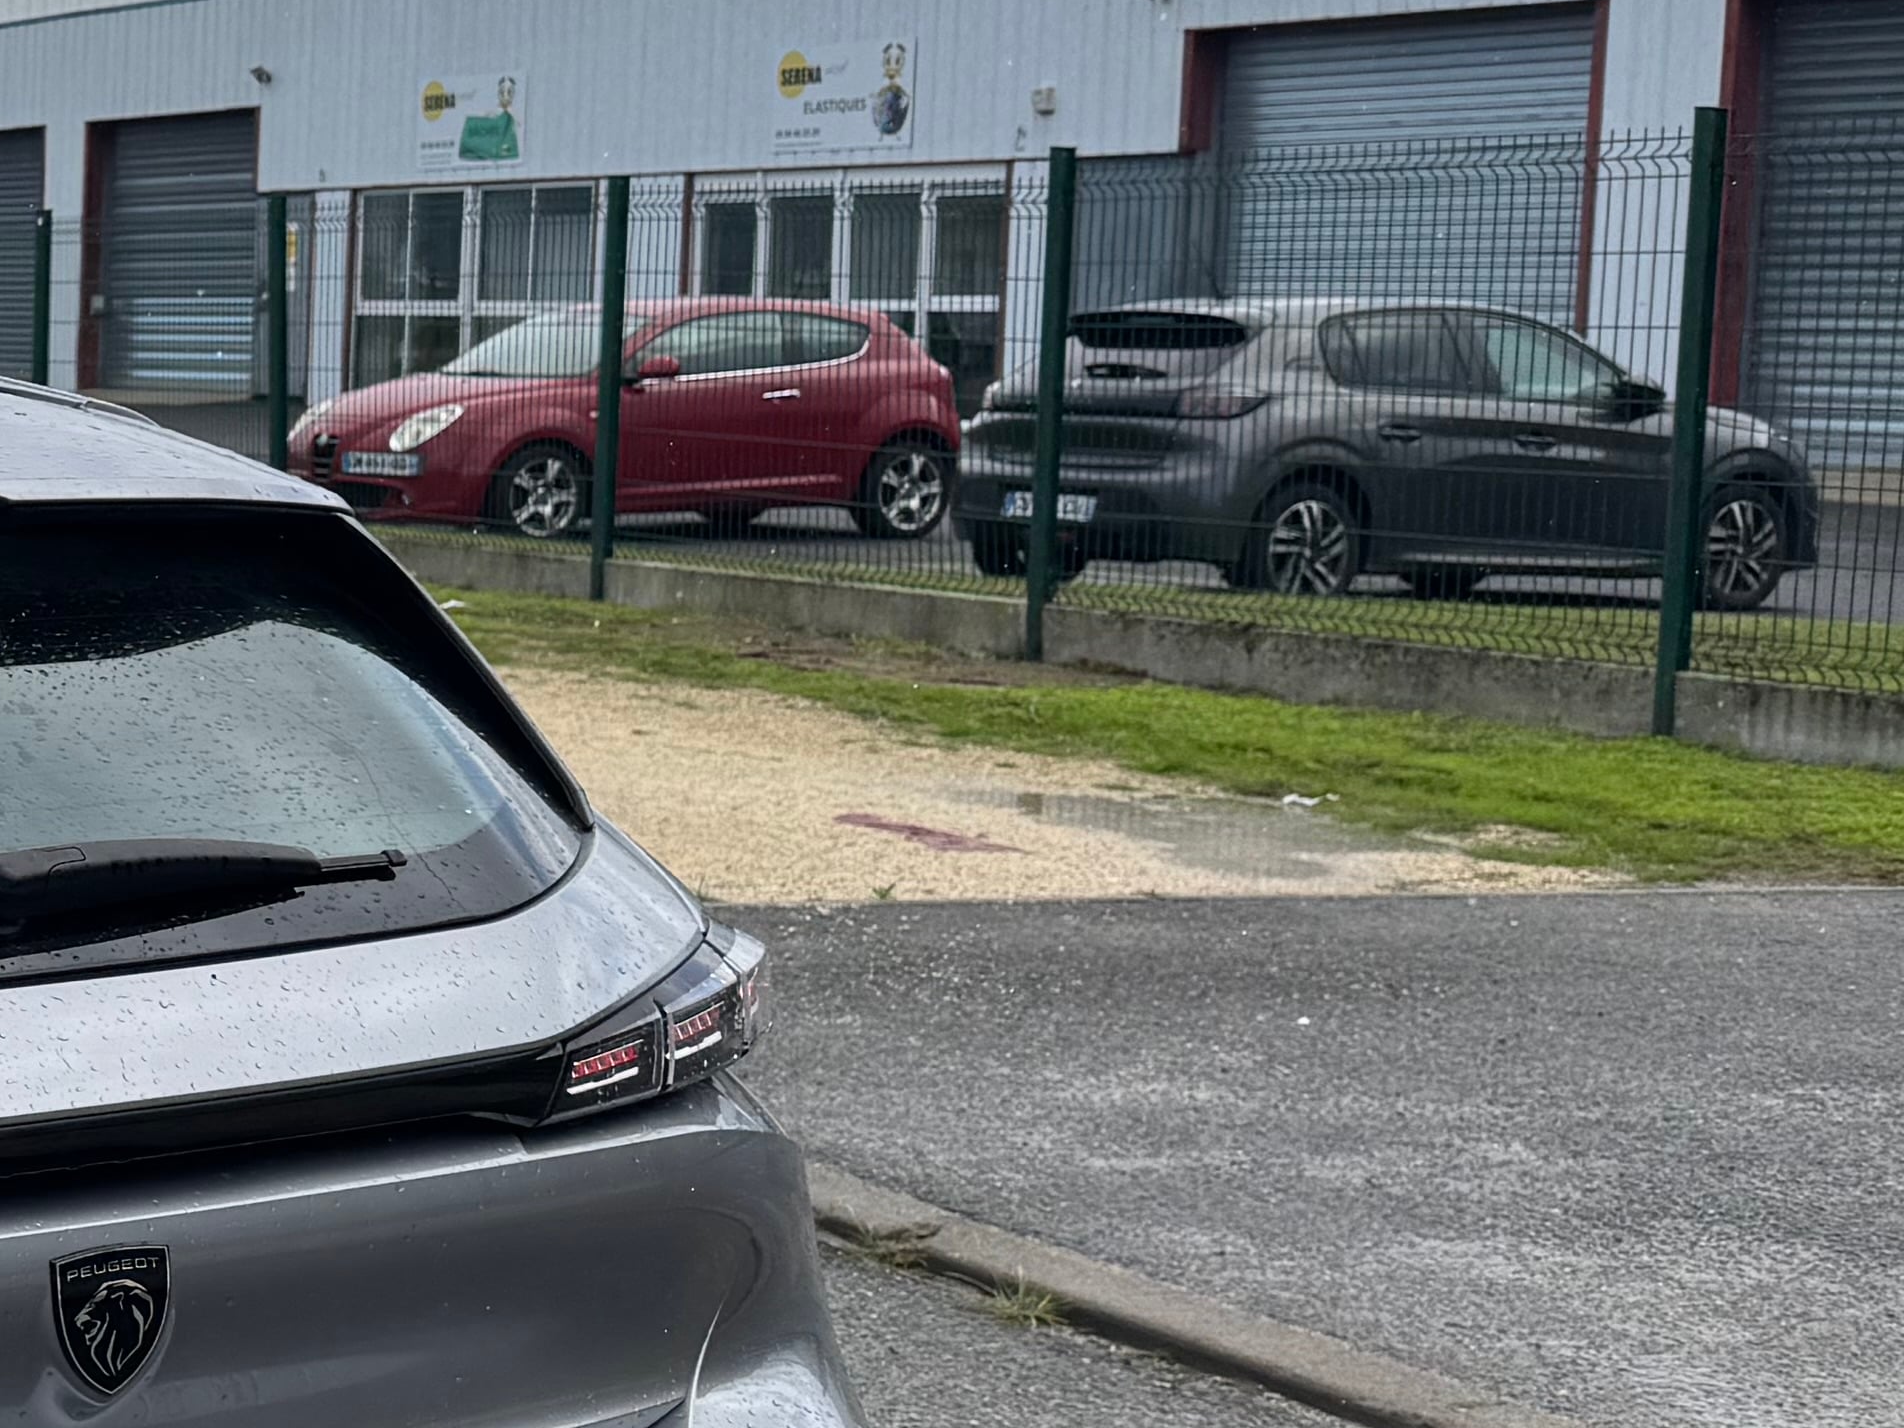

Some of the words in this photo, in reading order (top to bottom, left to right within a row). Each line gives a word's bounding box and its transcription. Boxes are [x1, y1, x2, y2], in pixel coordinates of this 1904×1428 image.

[781, 65, 822, 86] SERENA
[424, 93, 456, 112] SERENA
[66, 1256, 160, 1283] PEUGEOT
